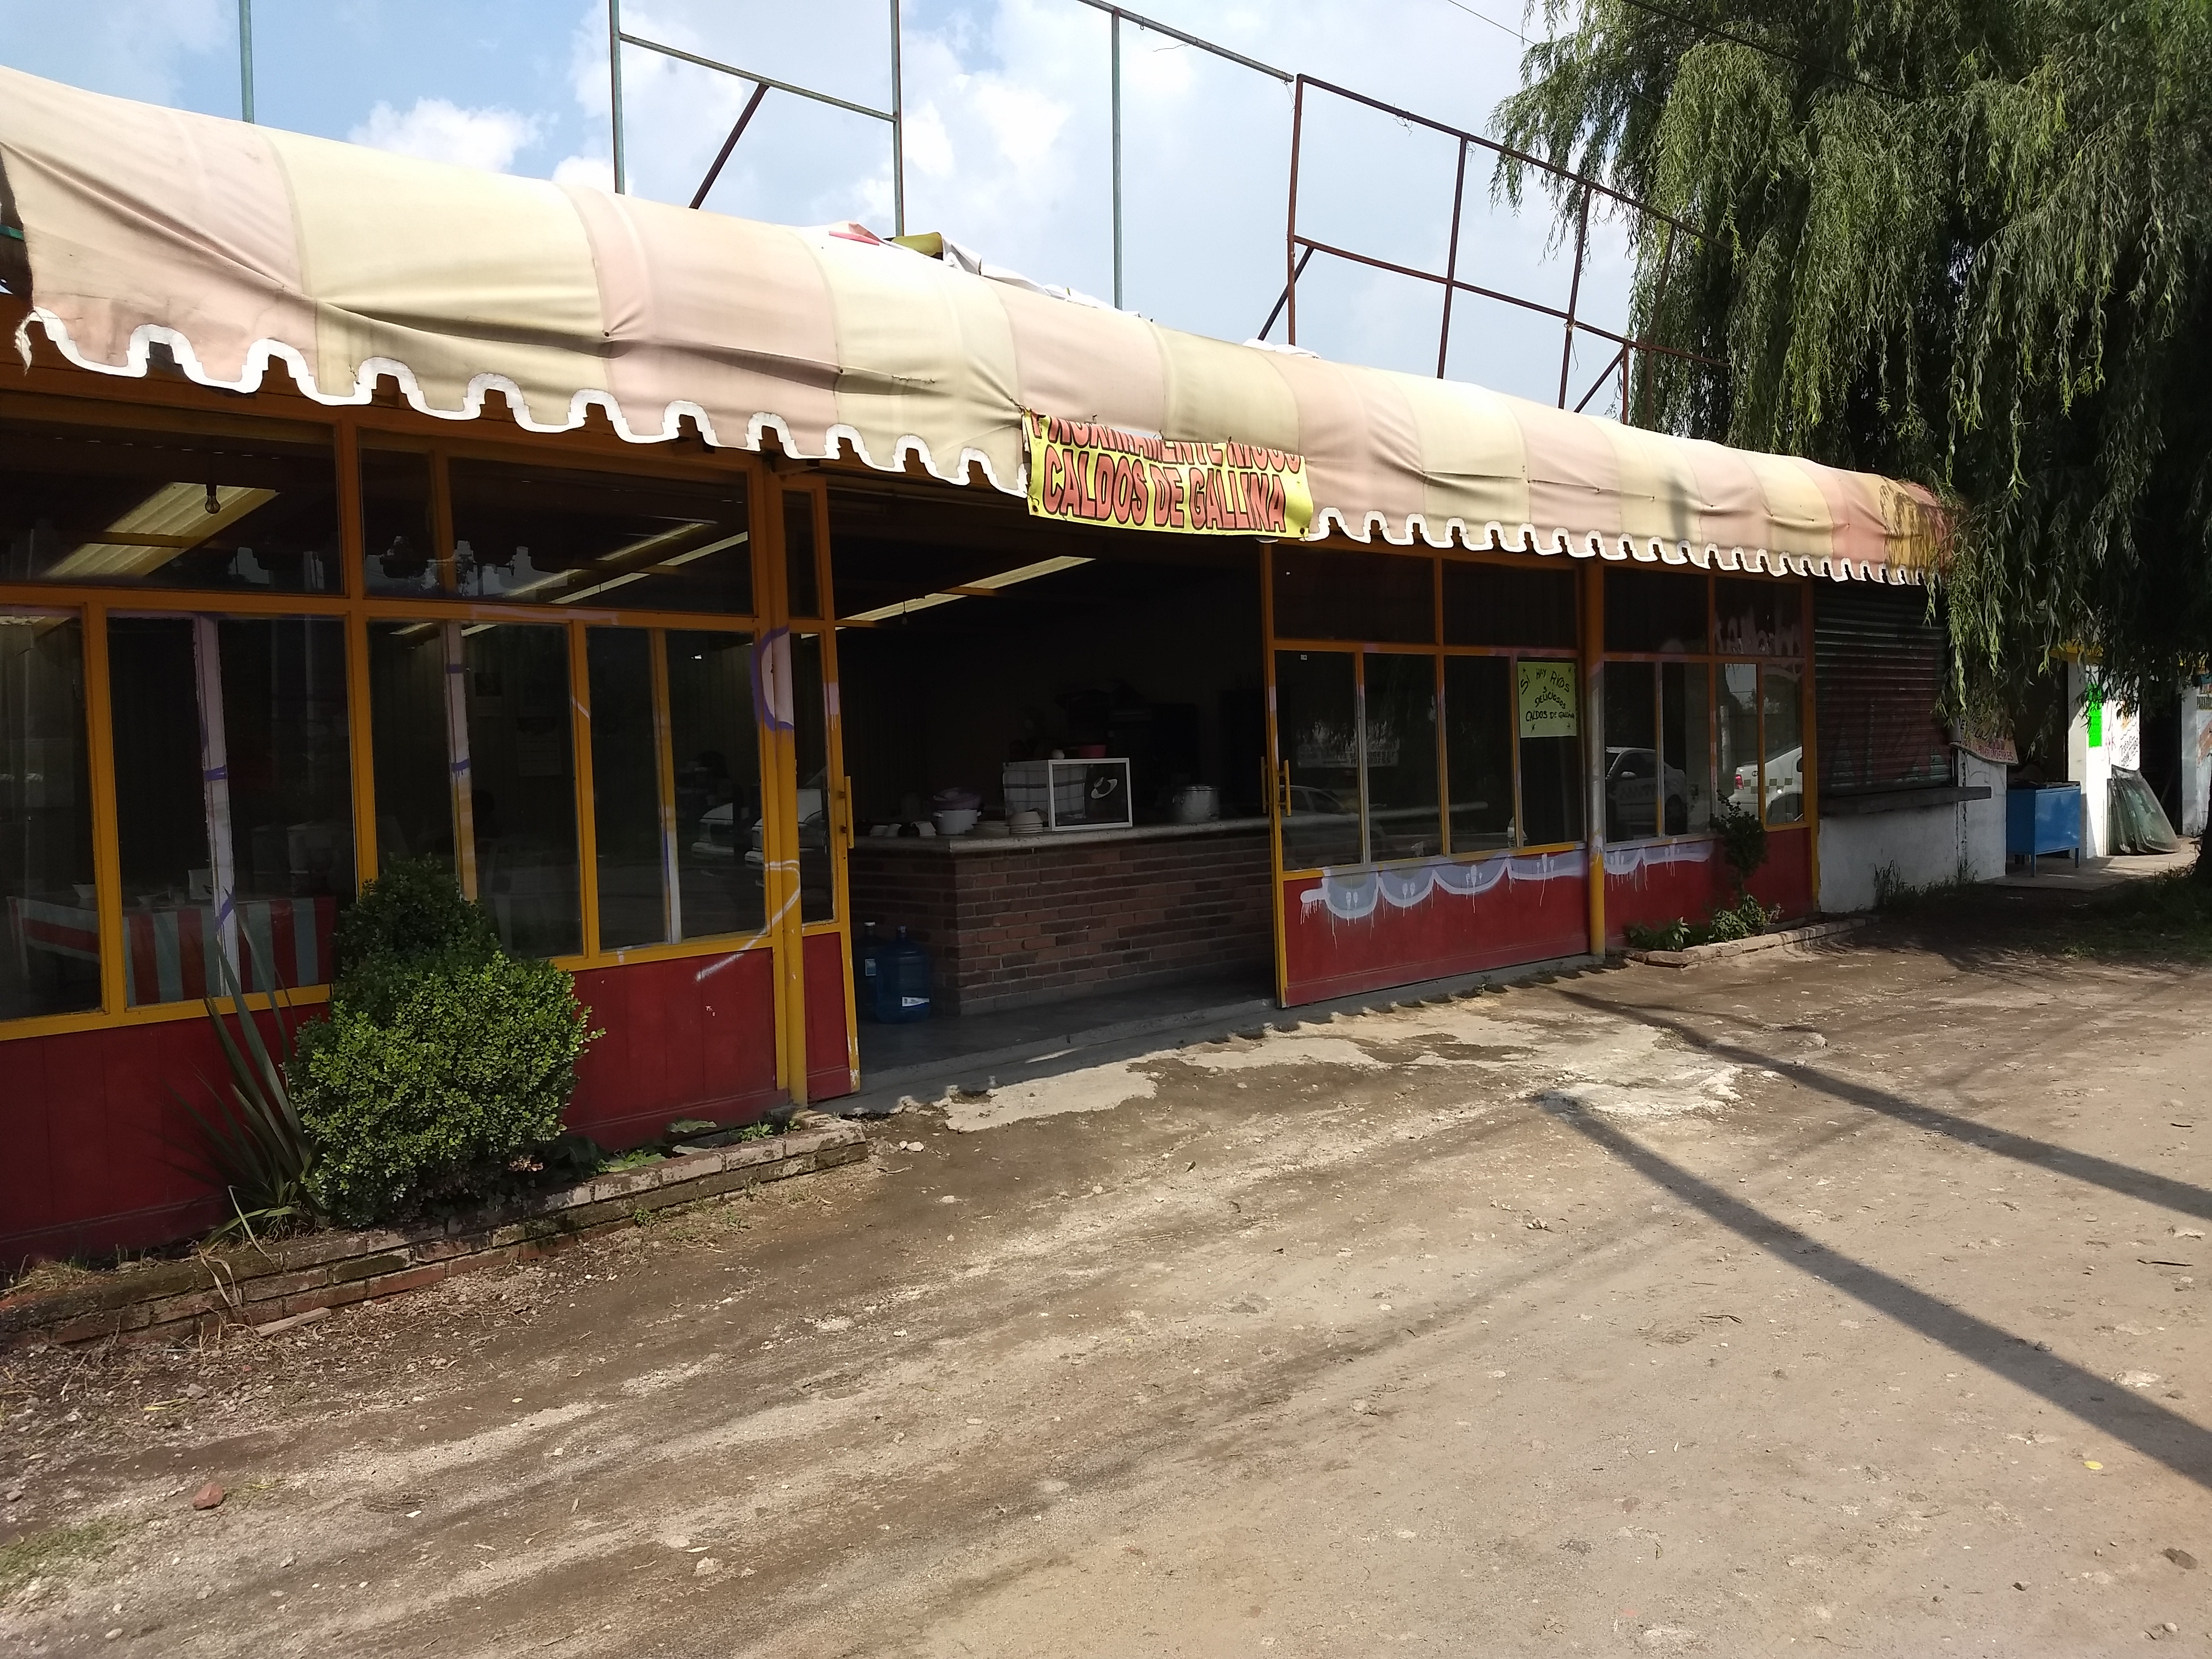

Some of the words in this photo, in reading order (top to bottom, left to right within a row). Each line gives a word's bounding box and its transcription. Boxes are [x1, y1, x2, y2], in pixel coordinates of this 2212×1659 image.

[1043, 444, 1148, 526] CALDOS
[1149, 463, 1184, 528] DE
[1189, 467, 1286, 533] GALLINA
[1536, 668, 1547, 680] HAY
[1526, 710, 1548, 722] CALDOS
